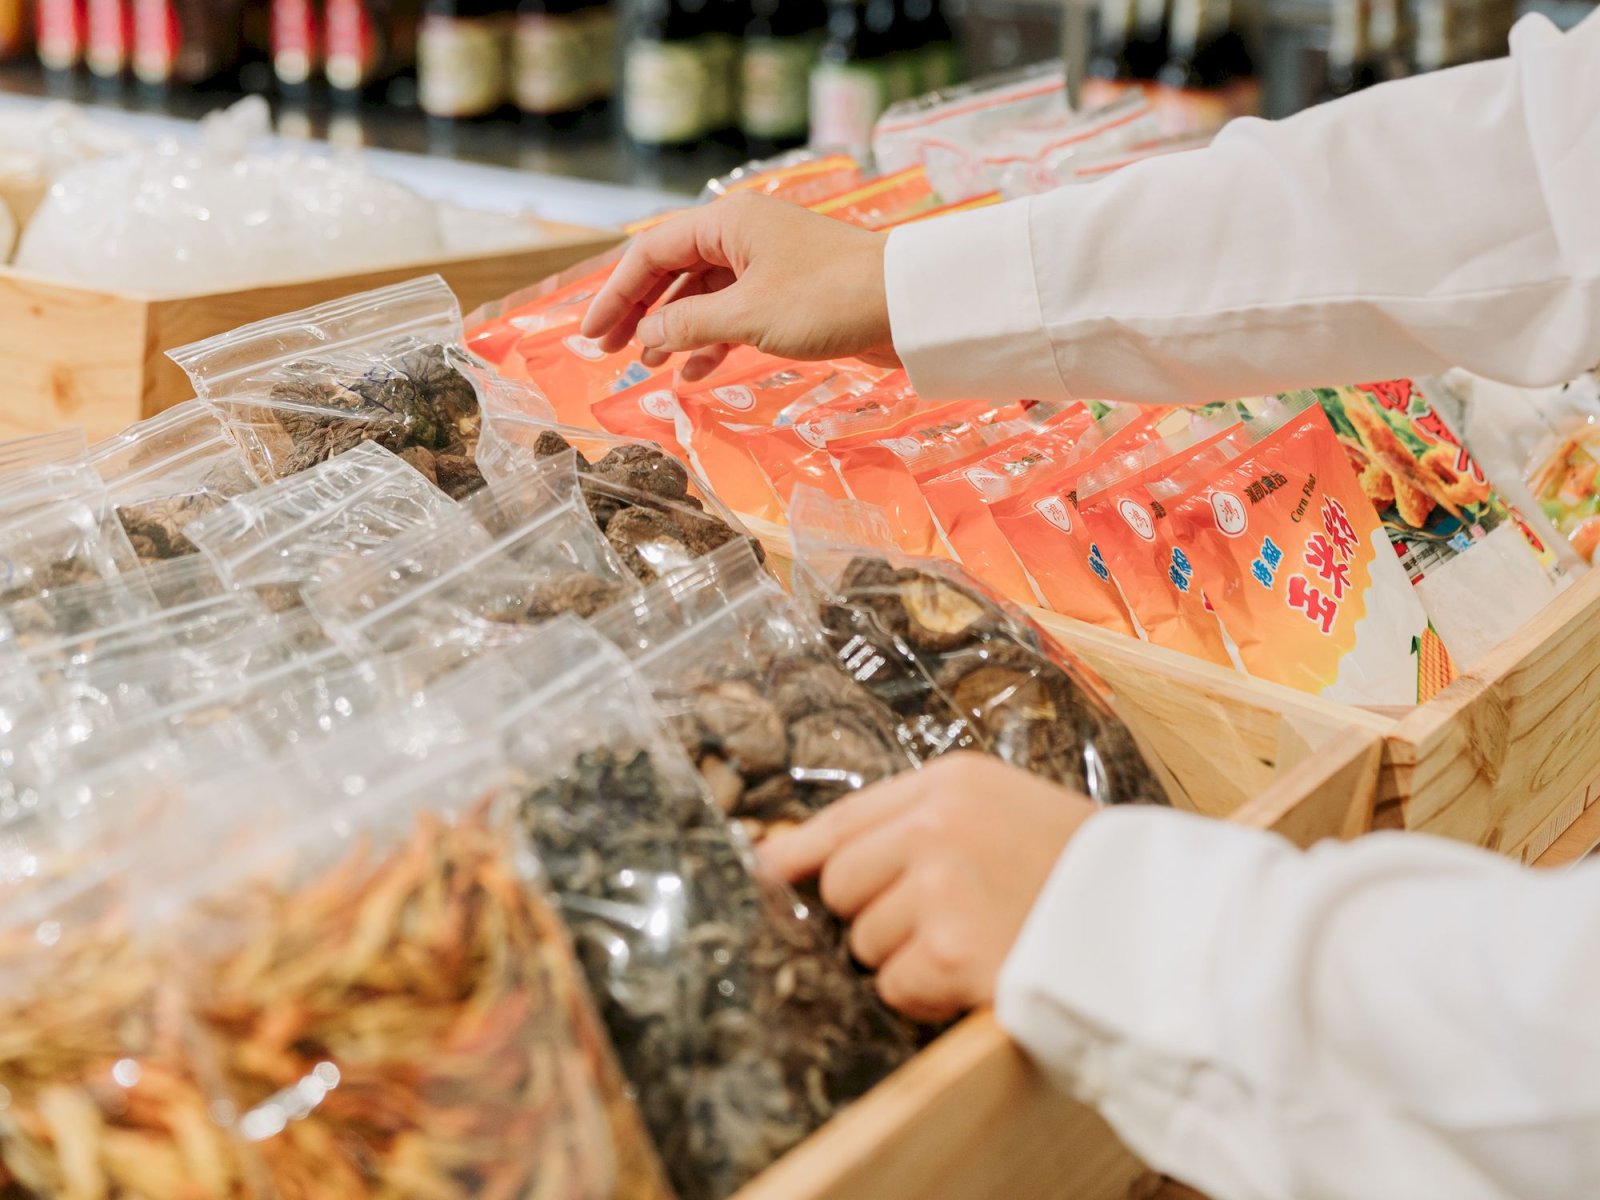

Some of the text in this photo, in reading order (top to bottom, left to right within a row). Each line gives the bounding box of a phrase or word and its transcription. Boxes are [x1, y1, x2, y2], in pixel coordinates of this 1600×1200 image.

[1290, 473, 1317, 523] Corn Flour
[1250, 536, 1283, 590] 特級
[1287, 494, 1359, 634] 玉米粉
